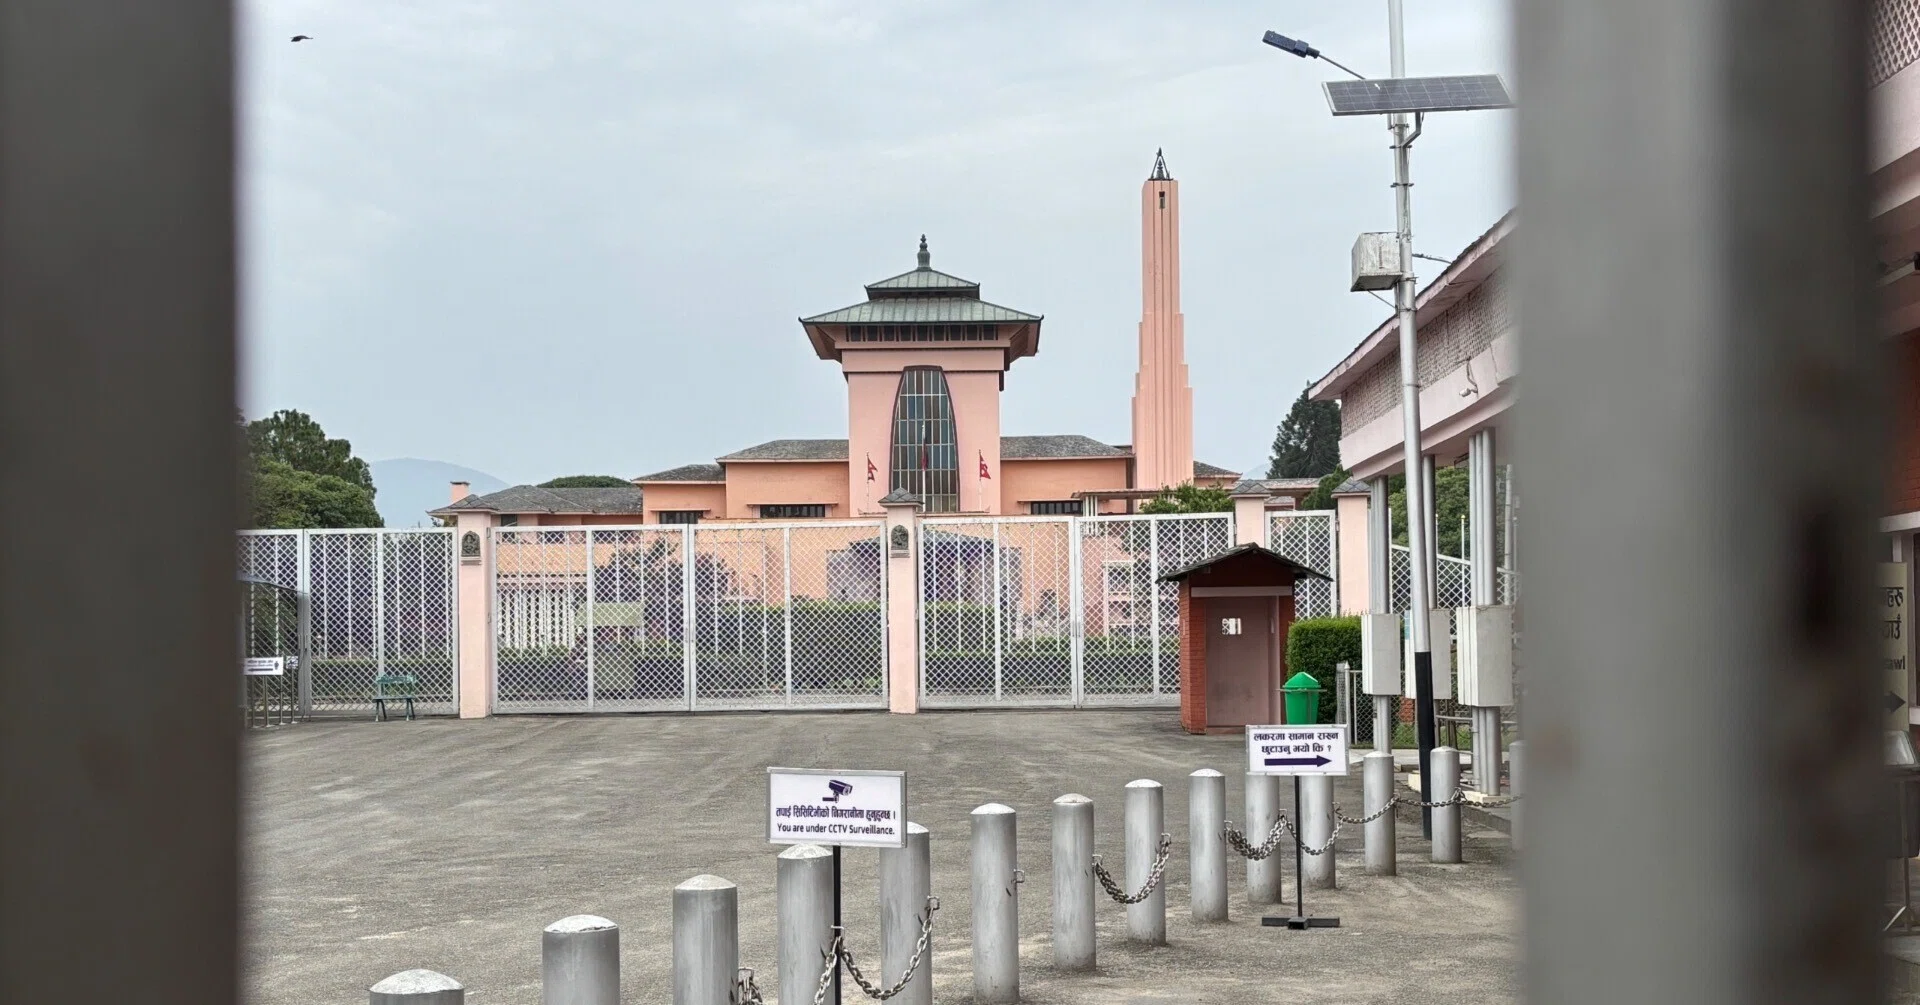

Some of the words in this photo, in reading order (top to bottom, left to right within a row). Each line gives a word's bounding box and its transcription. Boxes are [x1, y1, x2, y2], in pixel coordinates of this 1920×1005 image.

[1288, 732, 1314, 741] सामान
[1293, 743, 1310, 752] भयो
[1312, 742, 1324, 752] कि
[777, 823, 791, 832] You
[793, 825, 804, 833] are
[806, 824, 826, 833] under
[828, 824, 848, 834] CCTV
[849, 824, 895, 835] Surveillance.
